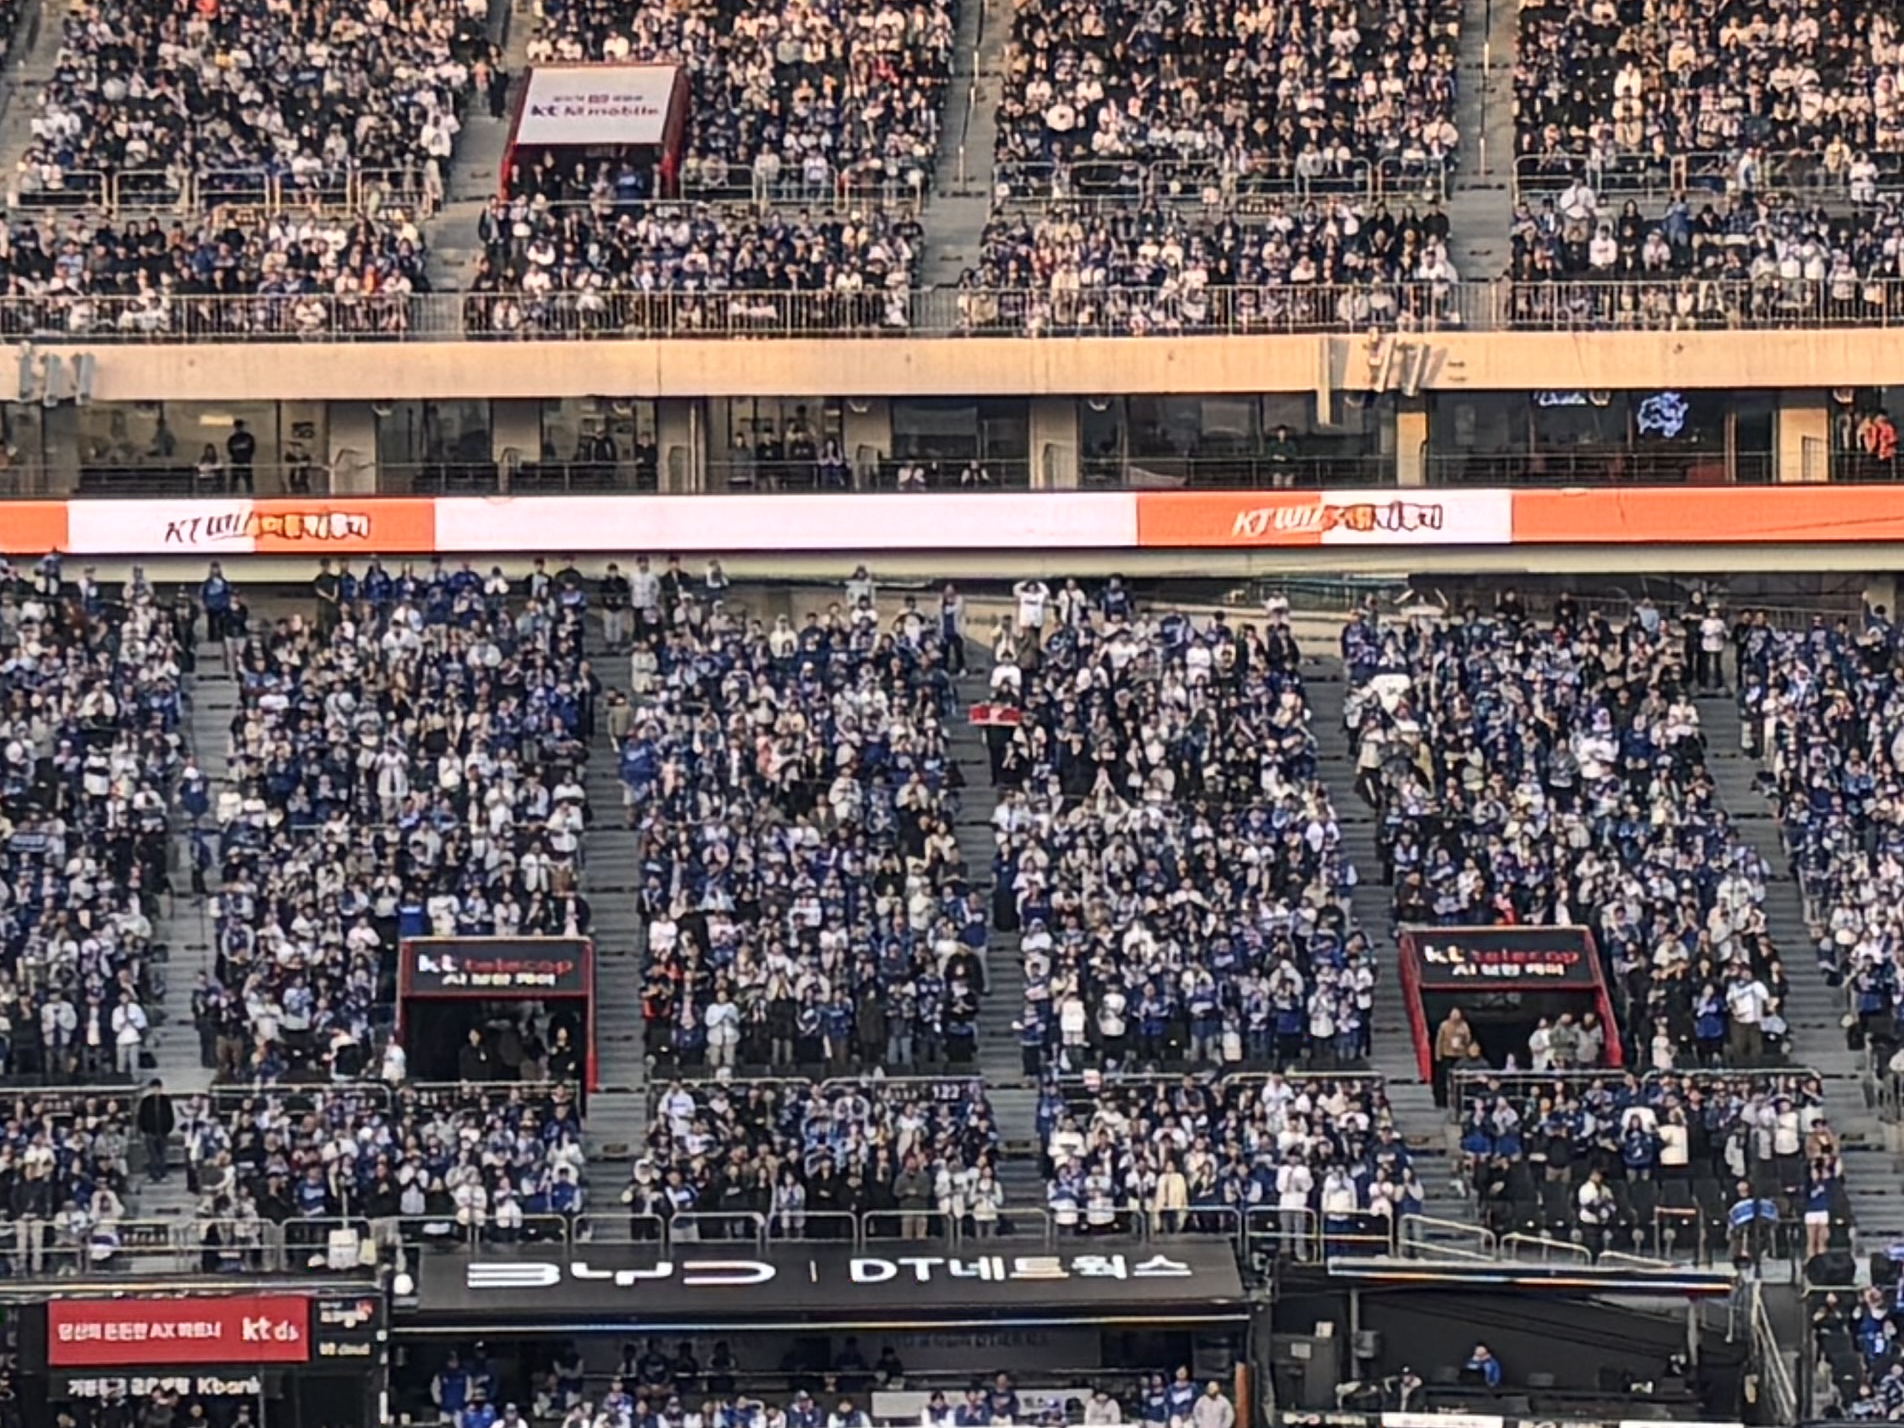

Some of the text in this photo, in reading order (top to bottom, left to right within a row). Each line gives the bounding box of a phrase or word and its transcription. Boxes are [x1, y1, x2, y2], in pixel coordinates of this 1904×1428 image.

[418, 953, 458, 973] kt
[1424, 945, 1465, 963] kt
[467, 1260, 776, 1287] BYD
[150, 1323, 176, 1338] AX
[242, 1317, 273, 1341] kt
[274, 1320, 299, 1341] ds
